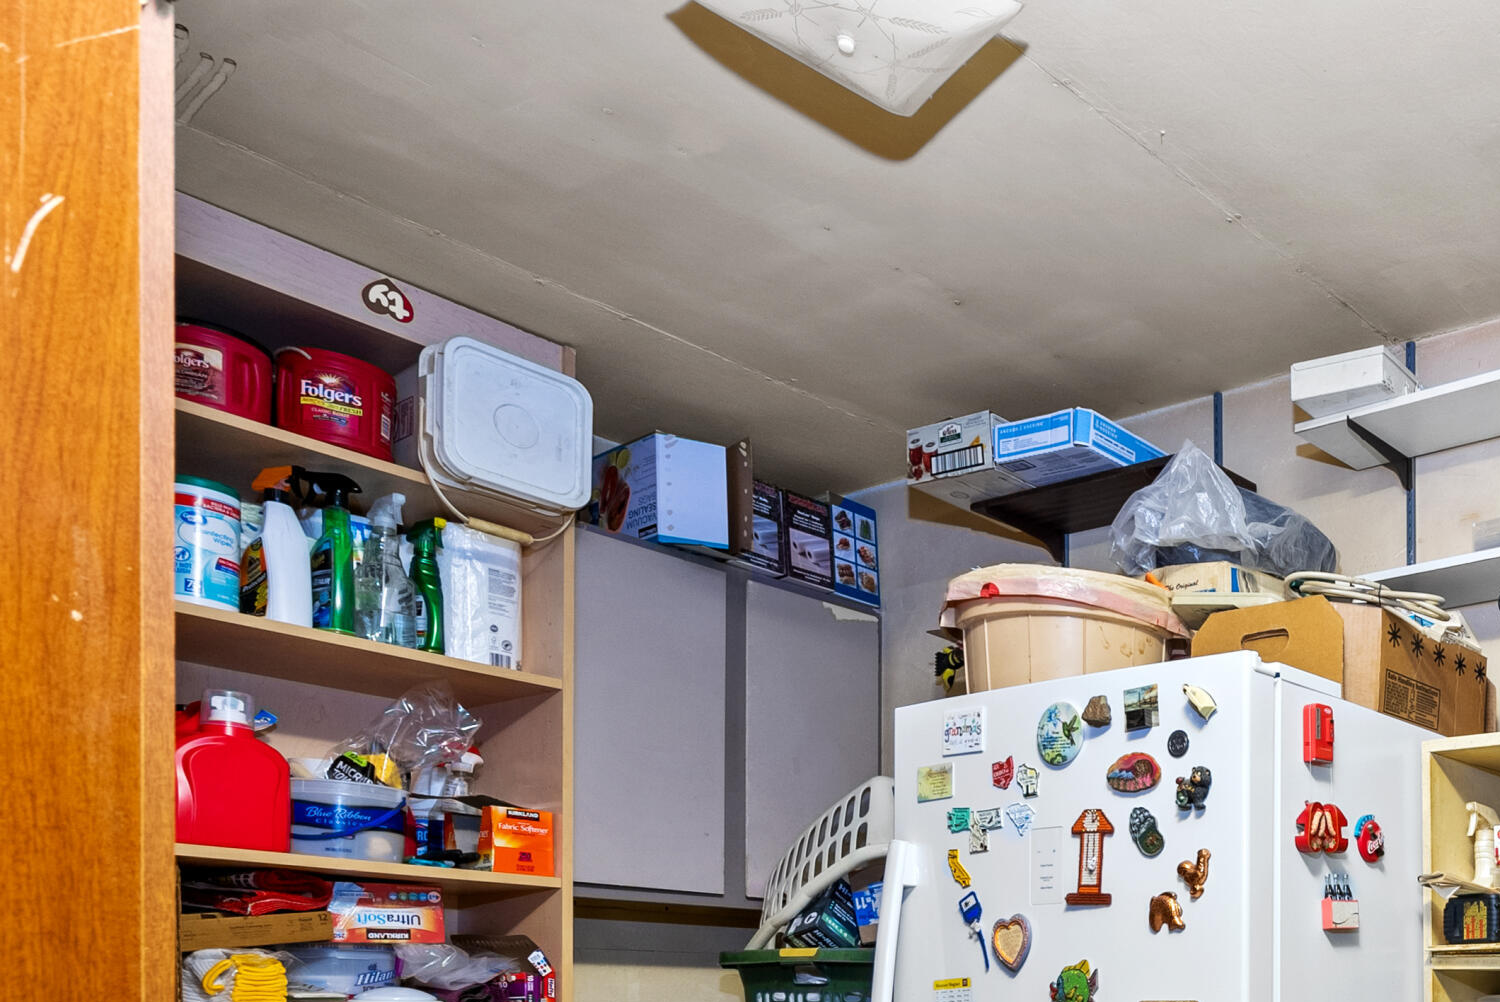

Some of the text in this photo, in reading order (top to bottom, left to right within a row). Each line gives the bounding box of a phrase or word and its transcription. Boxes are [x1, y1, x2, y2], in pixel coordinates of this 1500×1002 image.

[174, 352, 210, 369] olgers
[300, 379, 362, 407] Folgers
[305, 805, 371, 821] Blue Ribbon
[498, 822, 549, 835] Fabric Softener
[355, 913, 421, 927] UltraSoft
[367, 931, 410, 940] KIRKLAND
[357, 970, 393, 985] Hilan
